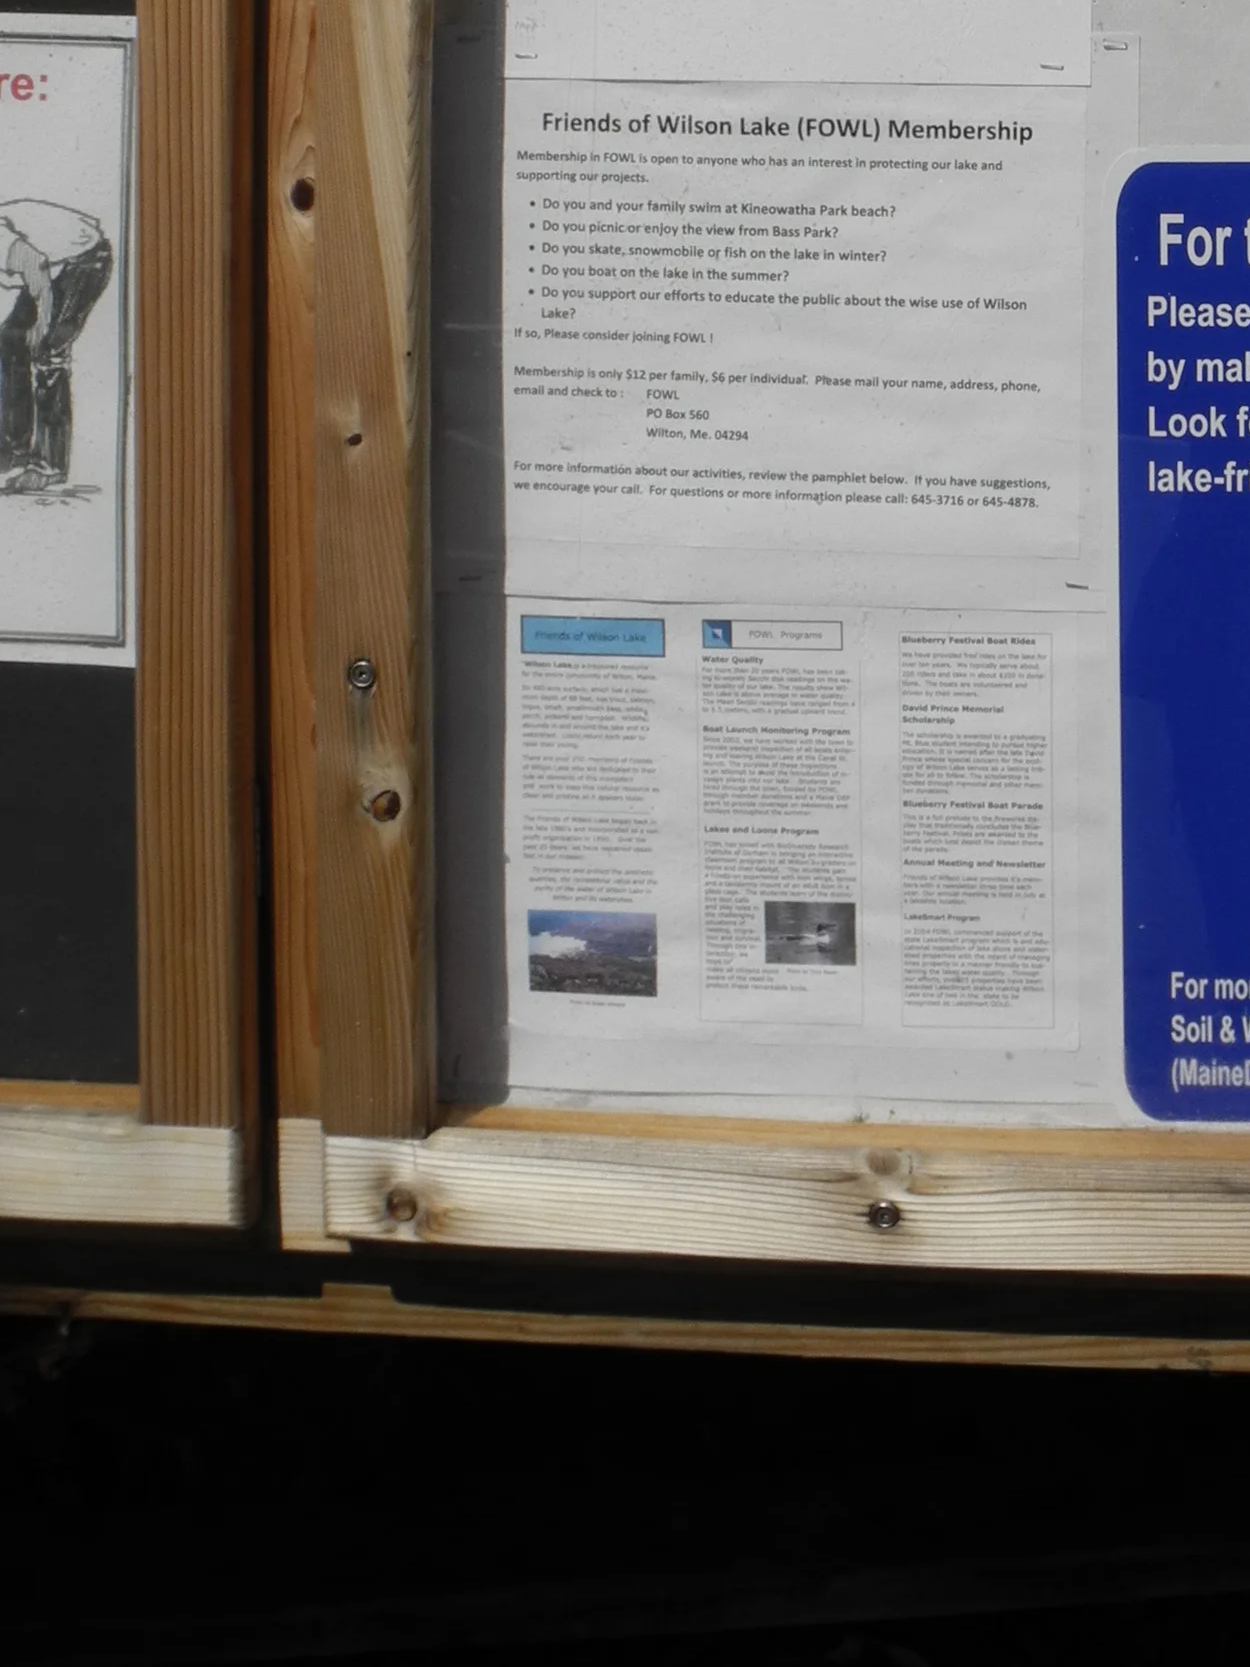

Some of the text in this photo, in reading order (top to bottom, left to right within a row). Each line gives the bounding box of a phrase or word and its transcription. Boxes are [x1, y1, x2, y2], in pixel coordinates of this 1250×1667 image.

[543, 113, 1032, 145] Friends of Wilson Lake (FOWL) Membership
[1160, 214, 1232, 266] For
[1148, 351, 1185, 390] by
[647, 389, 679, 400] FOWL
[647, 408, 709, 420] PO Box 560
[1149, 406, 1227, 437] Look
[646, 428, 748, 441] Wilton, Me. 04294
[1171, 972, 1208, 999] For
[1171, 1015, 1212, 1042] Soil
[1220, 1016, 1235, 1043] &
